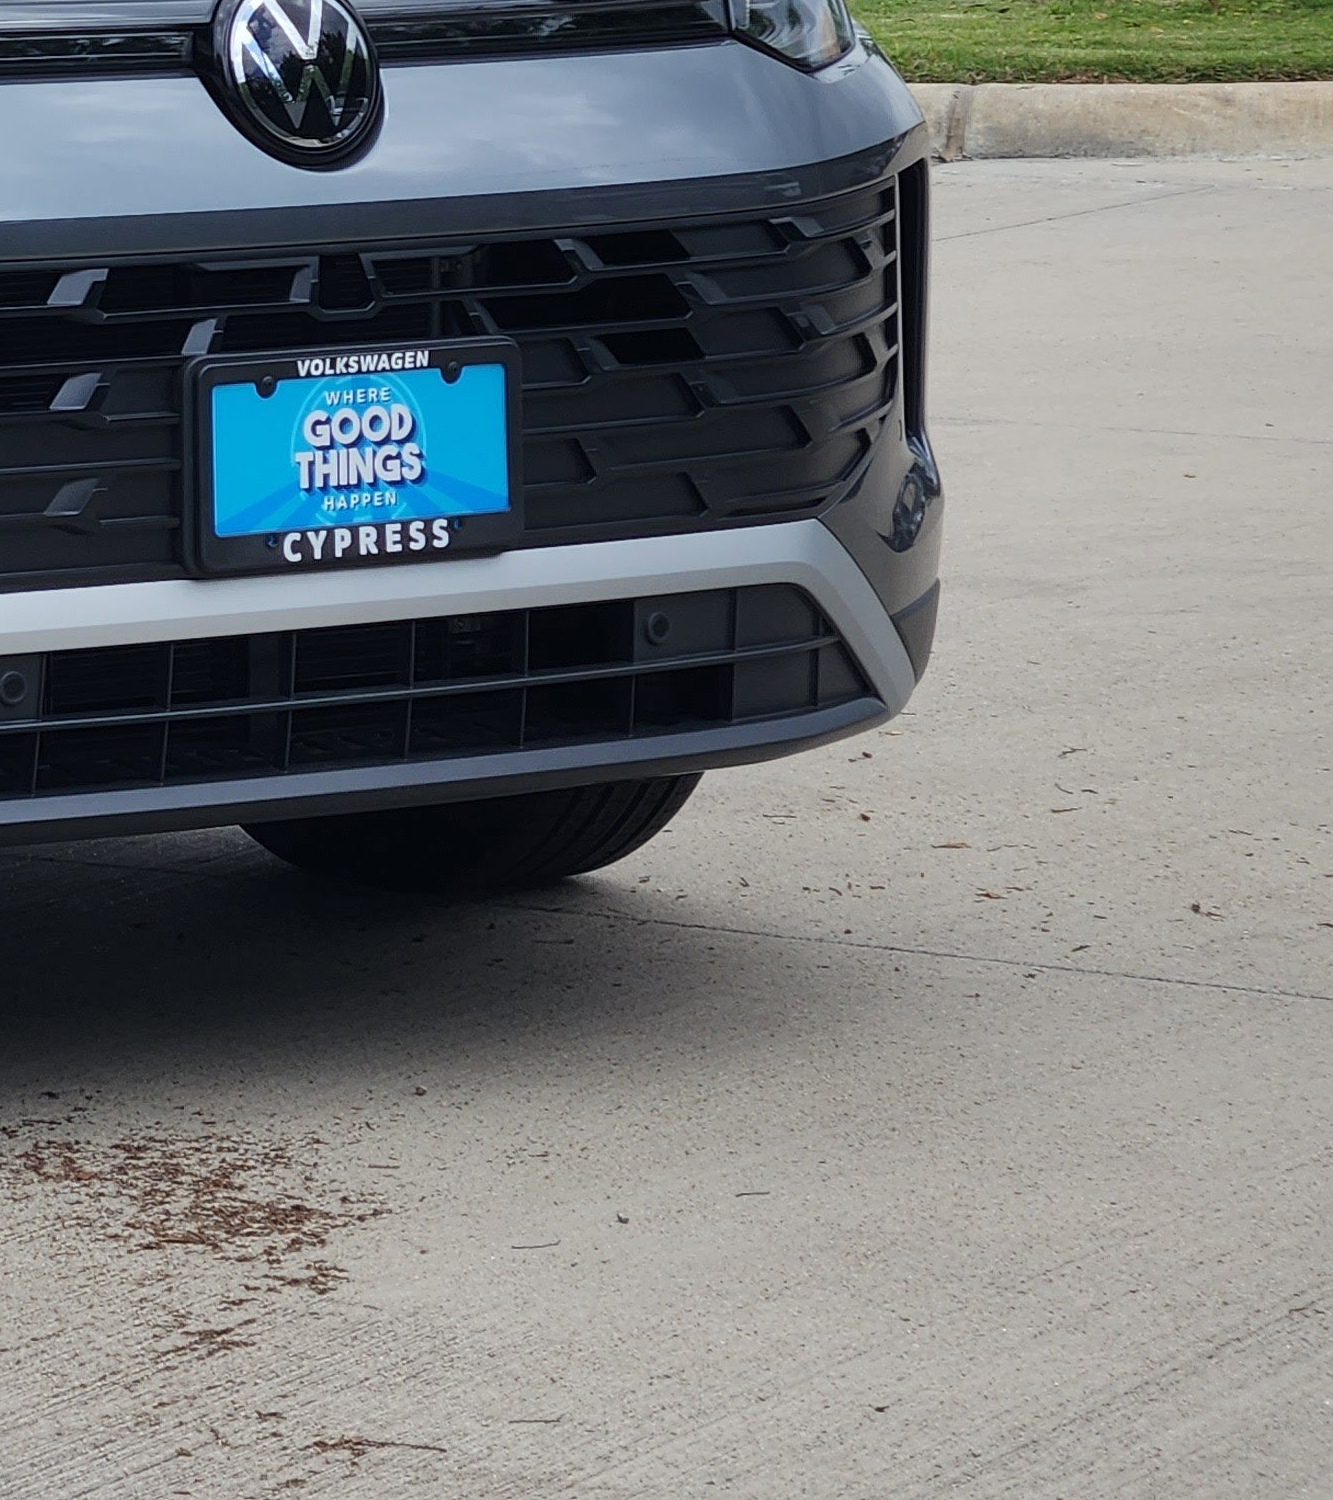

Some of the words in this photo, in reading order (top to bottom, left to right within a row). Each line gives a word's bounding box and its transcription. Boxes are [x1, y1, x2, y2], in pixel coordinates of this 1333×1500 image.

[297, 351, 429, 376] VOLKSWAGEN
[326, 387, 391, 405] WHERE
[303, 404, 413, 447] GOOD
[295, 443, 423, 488] THINGS
[324, 492, 397, 510] HAPPEN
[283, 518, 449, 562] CYPRESS
